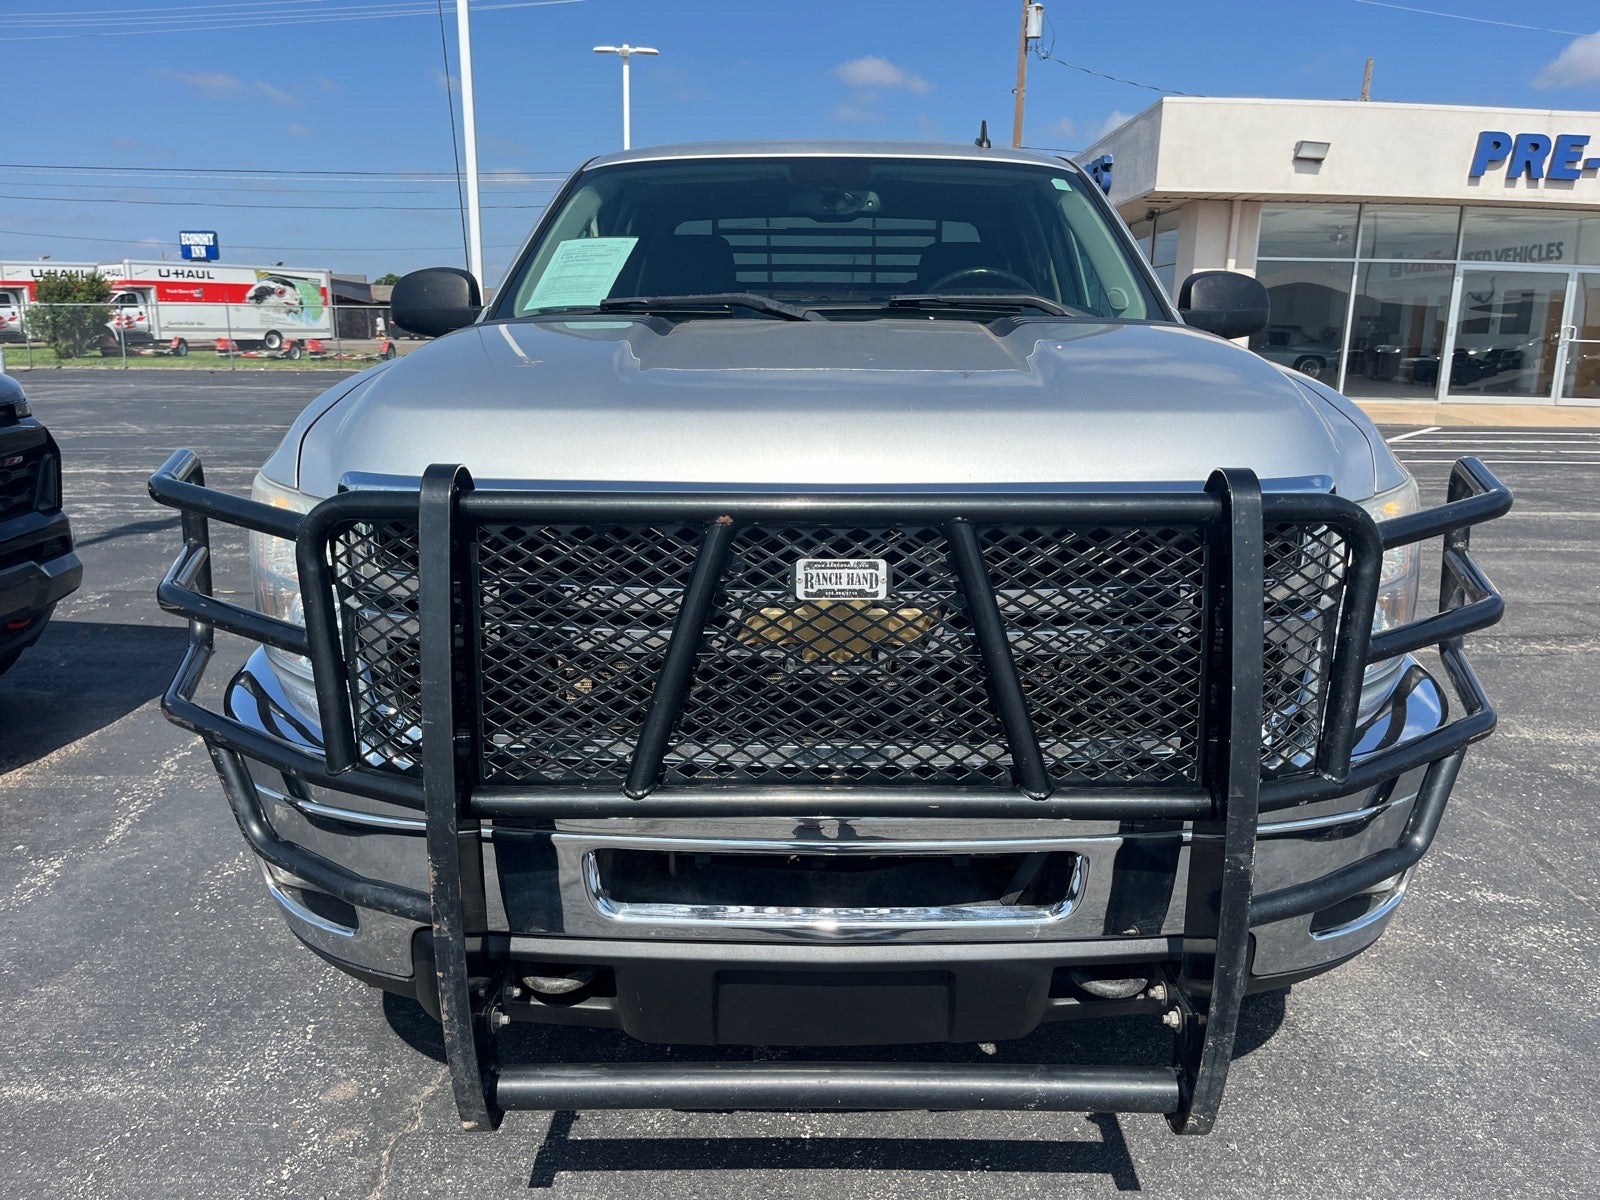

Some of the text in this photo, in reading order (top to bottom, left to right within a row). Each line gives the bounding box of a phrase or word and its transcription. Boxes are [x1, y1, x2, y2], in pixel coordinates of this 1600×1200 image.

[180, 233, 214, 245] ECONOMY
[191, 246, 206, 257] INN
[1494, 241, 1564, 263] VEHICLES
[158, 269, 215, 279] U-HAUL
[804, 572, 879, 589] RANCH HAND
